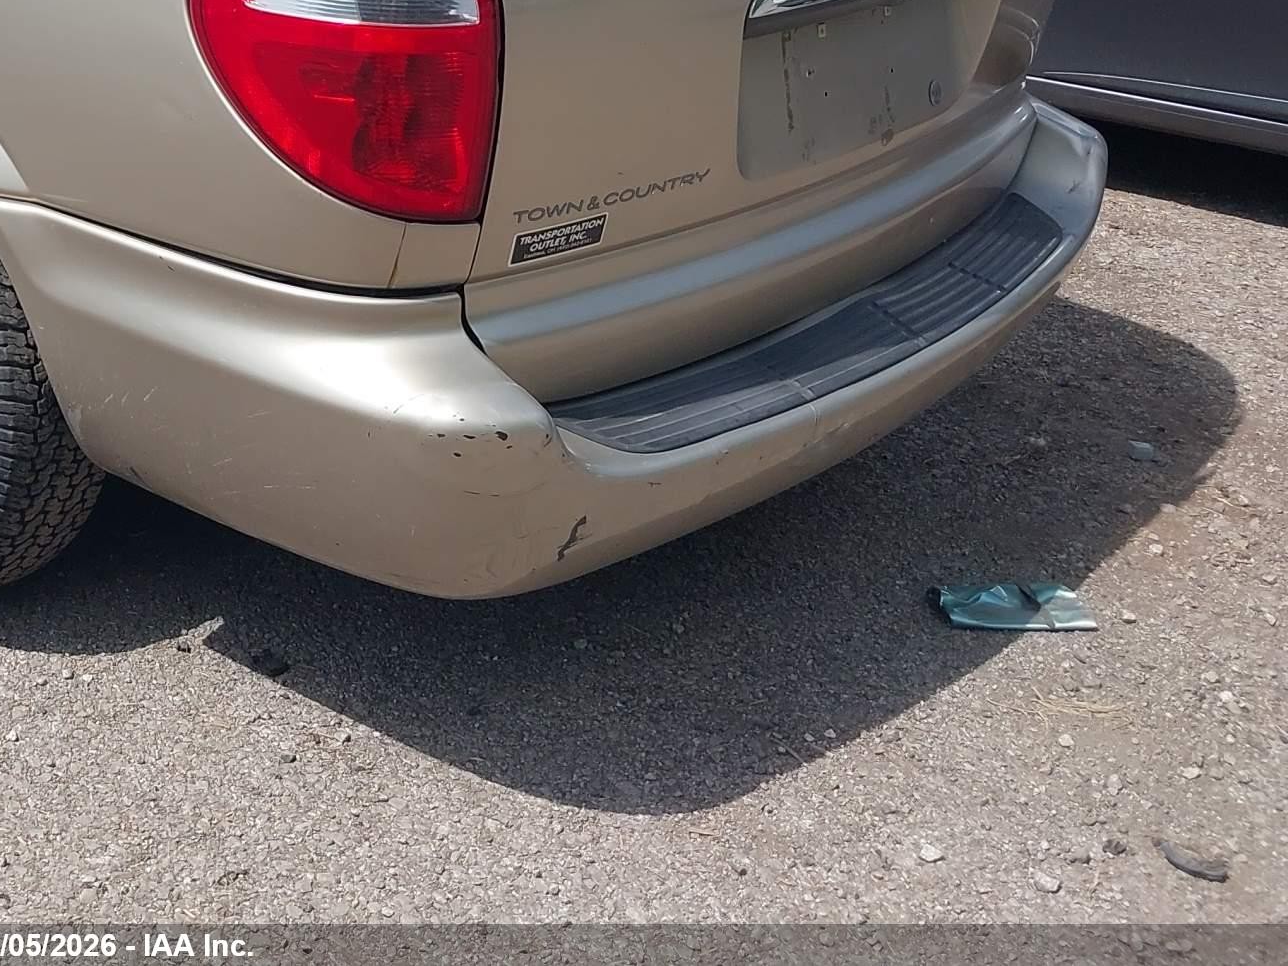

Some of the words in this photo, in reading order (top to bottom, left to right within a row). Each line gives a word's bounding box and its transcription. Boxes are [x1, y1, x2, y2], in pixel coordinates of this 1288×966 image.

[513, 199, 585, 224] TOWN
[587, 195, 600, 211] &
[603, 168, 711, 207] COUNTRY
[519, 217, 604, 246] TRANSPORTATION
